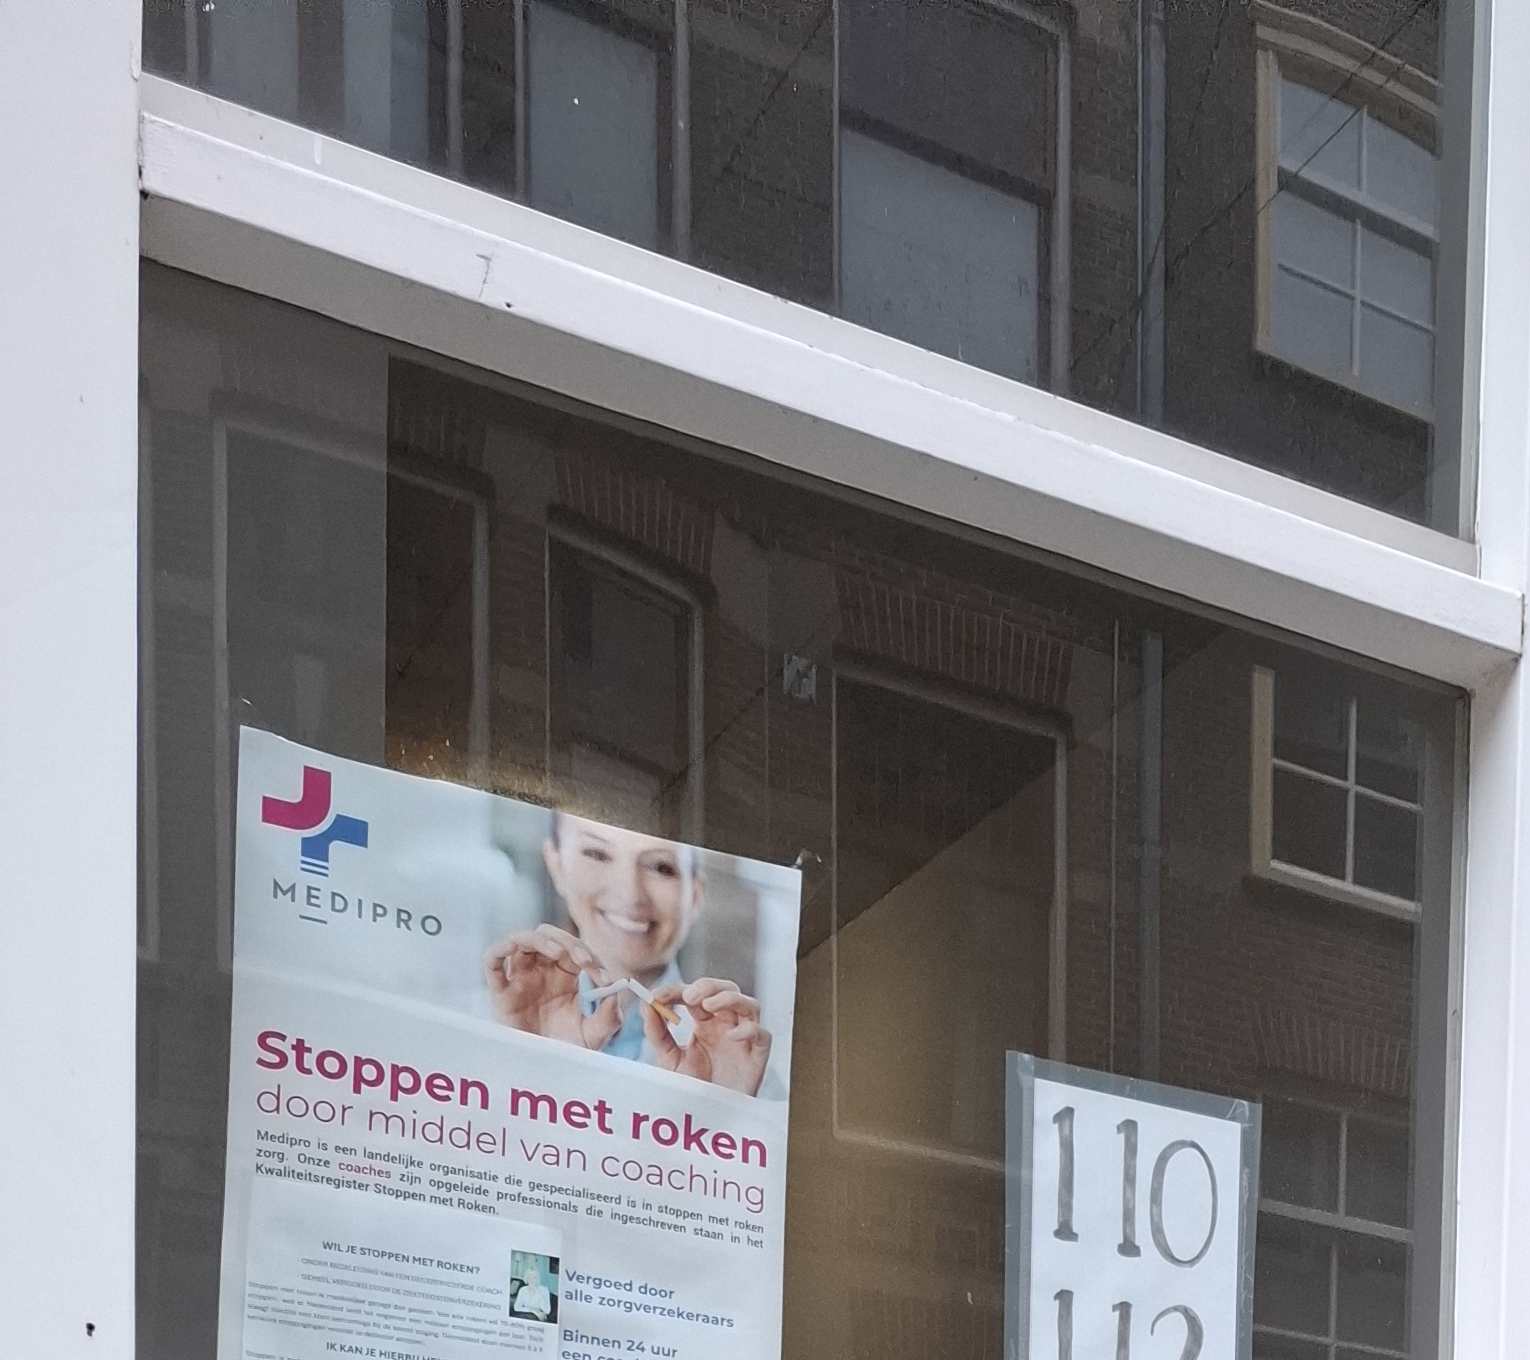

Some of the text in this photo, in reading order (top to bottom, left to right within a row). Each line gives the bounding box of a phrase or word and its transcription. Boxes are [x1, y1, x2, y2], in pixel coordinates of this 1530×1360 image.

[272, 877, 444, 937] MEDIPRO
[256, 1030, 767, 1168] Stoppen met roken
[257, 1084, 764, 1213] door middel van coaching
[255, 1163, 500, 1216] Kwaliteitsregister Stoppen met Roken.
[256, 1129, 764, 1233] Medipro is een landelijke organisatie die gespecialiseerd is in stoppen met roken
[256, 1148, 764, 1249] zorg. Onze coaches zijn opgeleide professionals die ingeschreven staan in het
[1052, 1106, 1218, 1268] 110
[322, 1240, 480, 1275] WIL JE STOPPEN MET ROKEN?
[565, 1269, 675, 1299] Vergoed door
[564, 1289, 735, 1328] alle zorgverzekeraars
[326, 1341, 337, 1352] IK
[339, 1344, 363, 1356] KAN
[365, 1347, 376, 1357] JE
[563, 1329, 678, 1358] Binnen 24 uur
